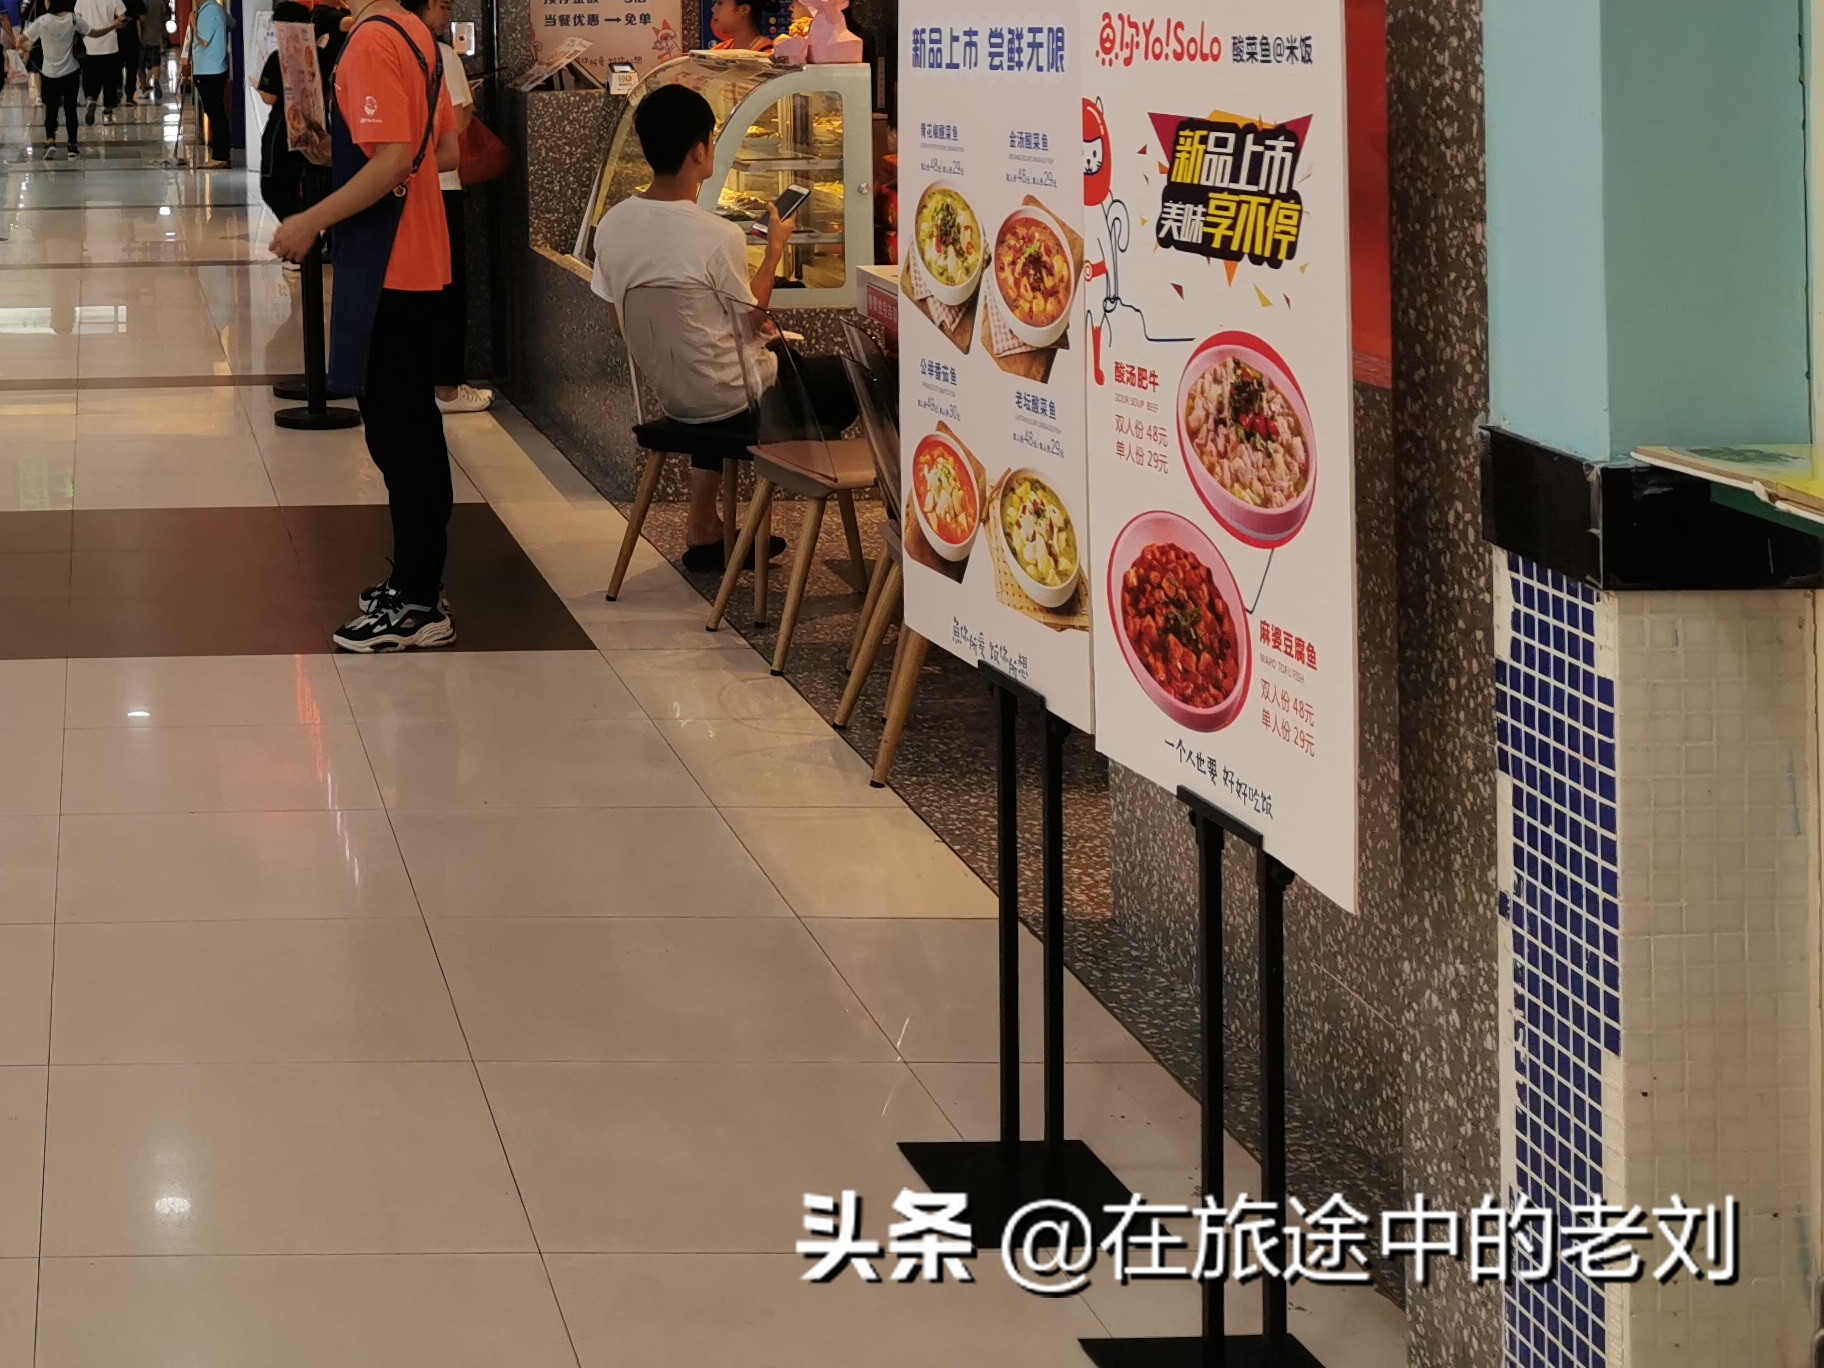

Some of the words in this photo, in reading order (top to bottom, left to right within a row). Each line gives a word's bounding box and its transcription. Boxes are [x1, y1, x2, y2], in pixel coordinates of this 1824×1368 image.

[544, 14, 600, 27] 当餐优惠
[624, 13, 652, 26] 免单
[912, 27, 979, 70] 新品上市
[988, 26, 1066, 72] 尝鲜无限
[1231, 34, 1313, 65] 酸菜鱼@米饭
[1171, 129, 1296, 195] 新品上市
[1158, 191, 1302, 260] 美味享不停
[1114, 361, 1159, 392] 酸汤肥牛
[1115, 393, 1129, 404] SOUR
[1130, 396, 1145, 408] SOUP
[1115, 414, 1144, 440] 双人份
[1146, 423, 1169, 447] 48元
[1116, 440, 1144, 466] 单人份
[1147, 450, 1169, 475] 29元
[1259, 619, 1317, 671] 麻婆豆腐鱼
[1260, 653, 1277, 670] MAPO
[1260, 678, 1290, 713] 双人份
[1292, 697, 1315, 728] 48元
[1261, 708, 1290, 743] 单人份
[1293, 726, 1315, 758] 29元
[1164, 739, 1218, 786] 一个人也要
[1222, 765, 1274, 820] 好好吃饭
